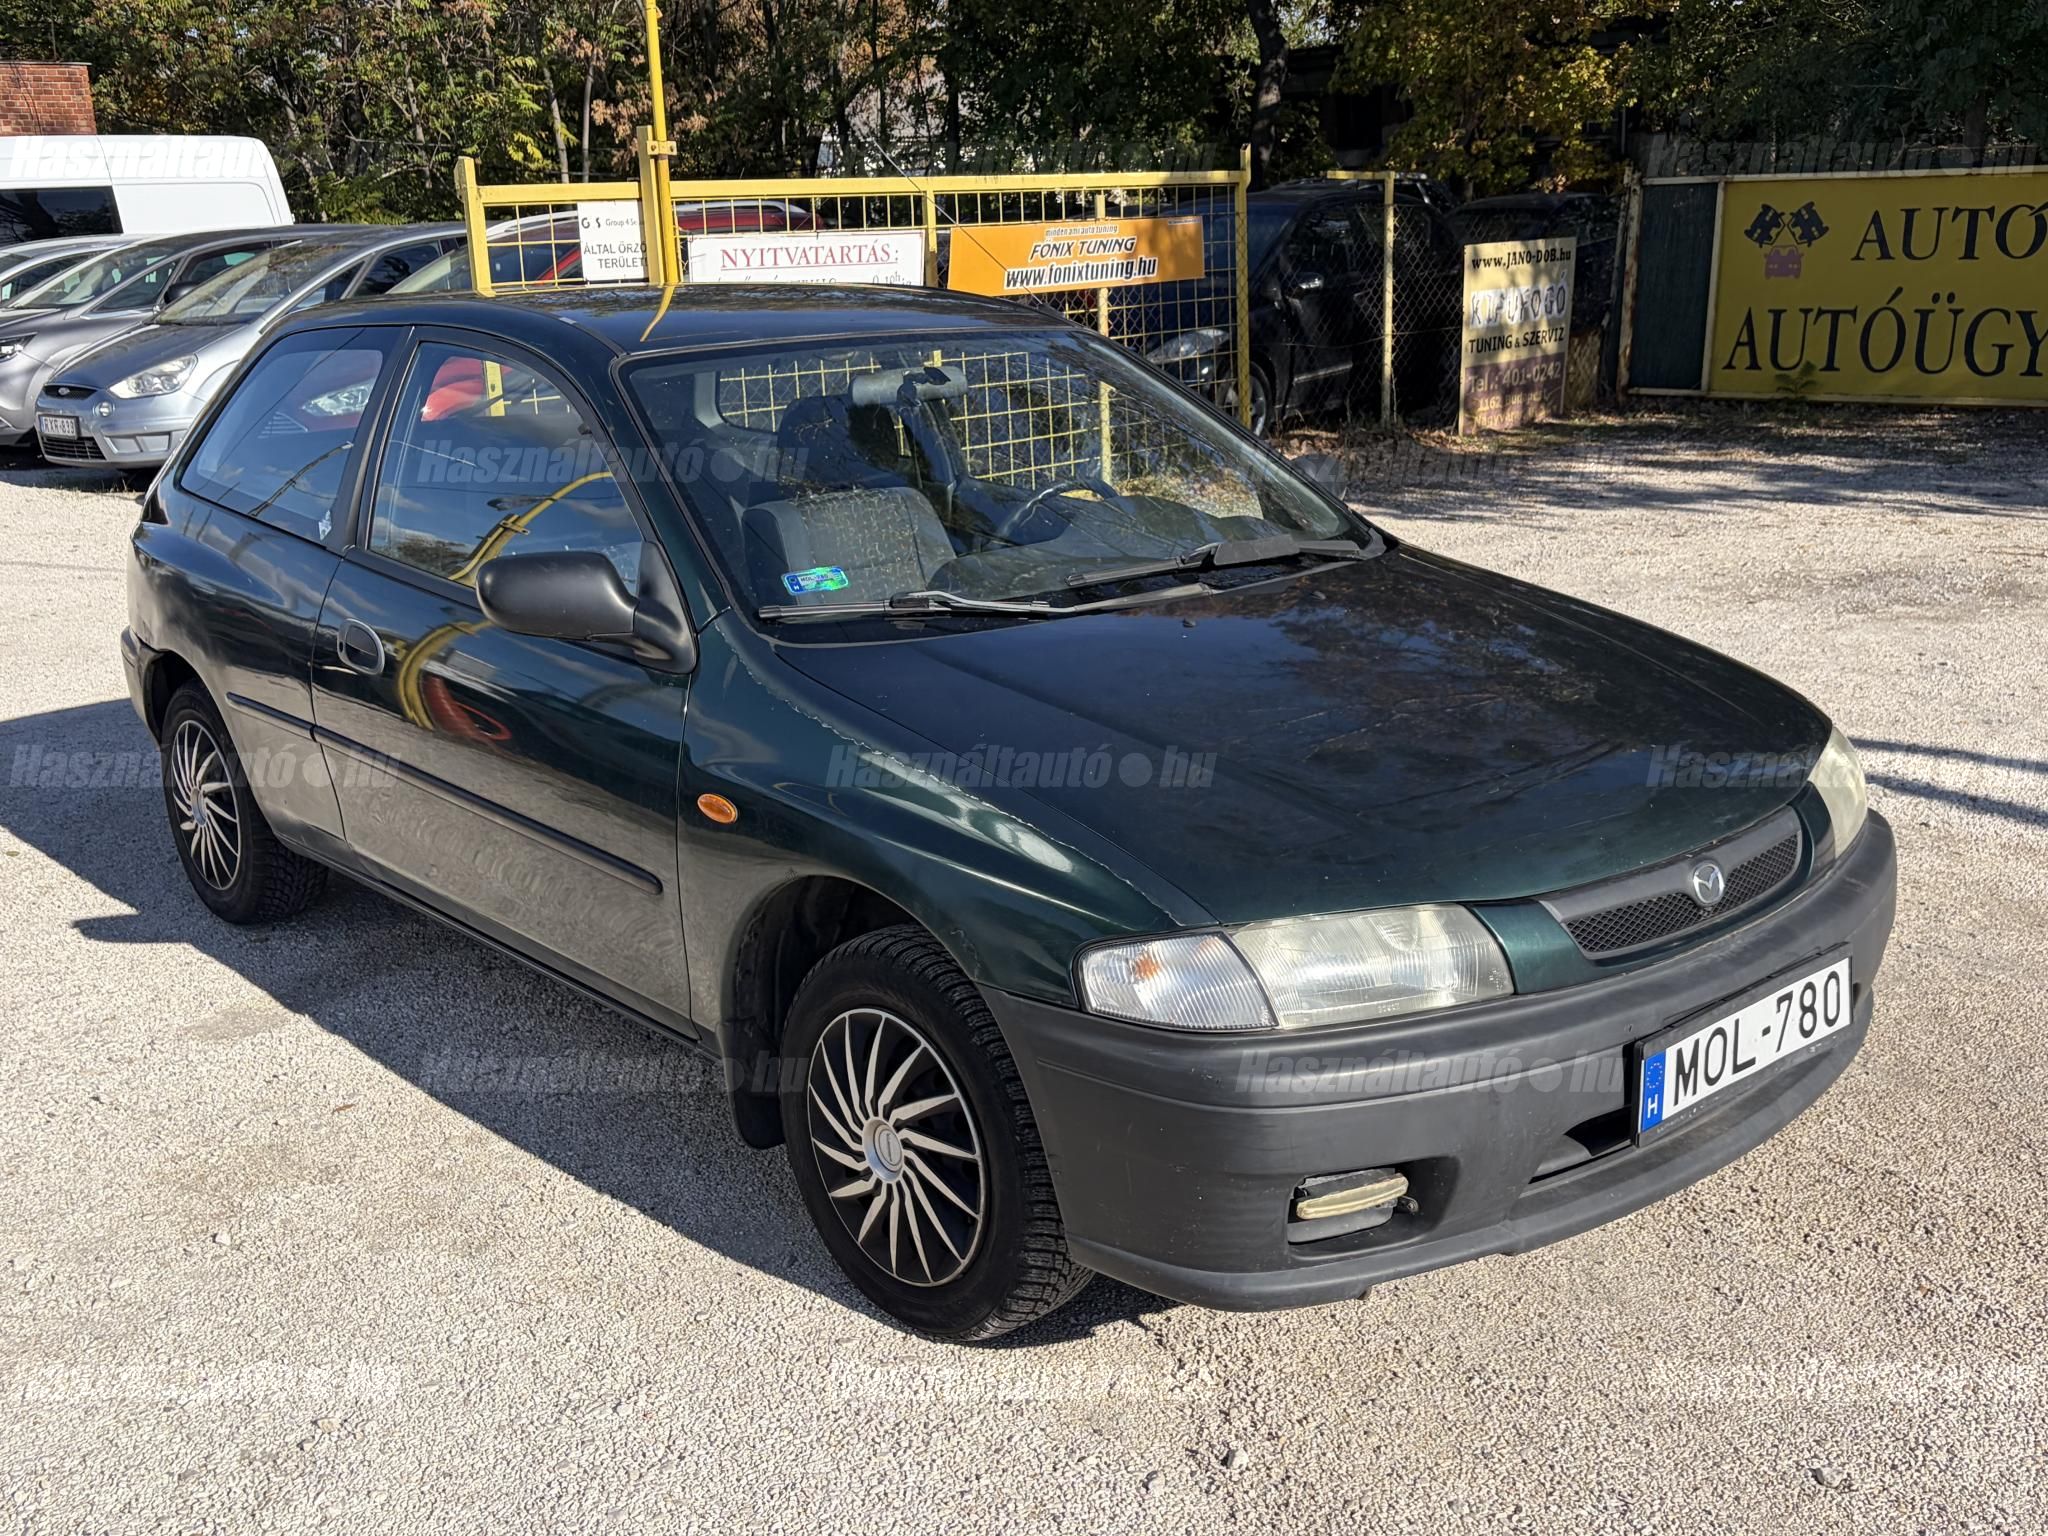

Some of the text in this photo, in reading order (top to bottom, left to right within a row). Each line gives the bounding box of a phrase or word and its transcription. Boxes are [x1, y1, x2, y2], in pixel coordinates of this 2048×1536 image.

[1079, 237, 1136, 256] TUNING
[1472, 247, 1571, 270] www.JANO-DOB.hu
[1005, 257, 1158, 287] www.fonixtuning.hu
[1469, 334, 1513, 353] TUNING
[1522, 327, 1565, 347] SZERVIZ
[1673, 970, 1841, 1107] MOL-780
[1646, 1094, 1659, 1119] H
